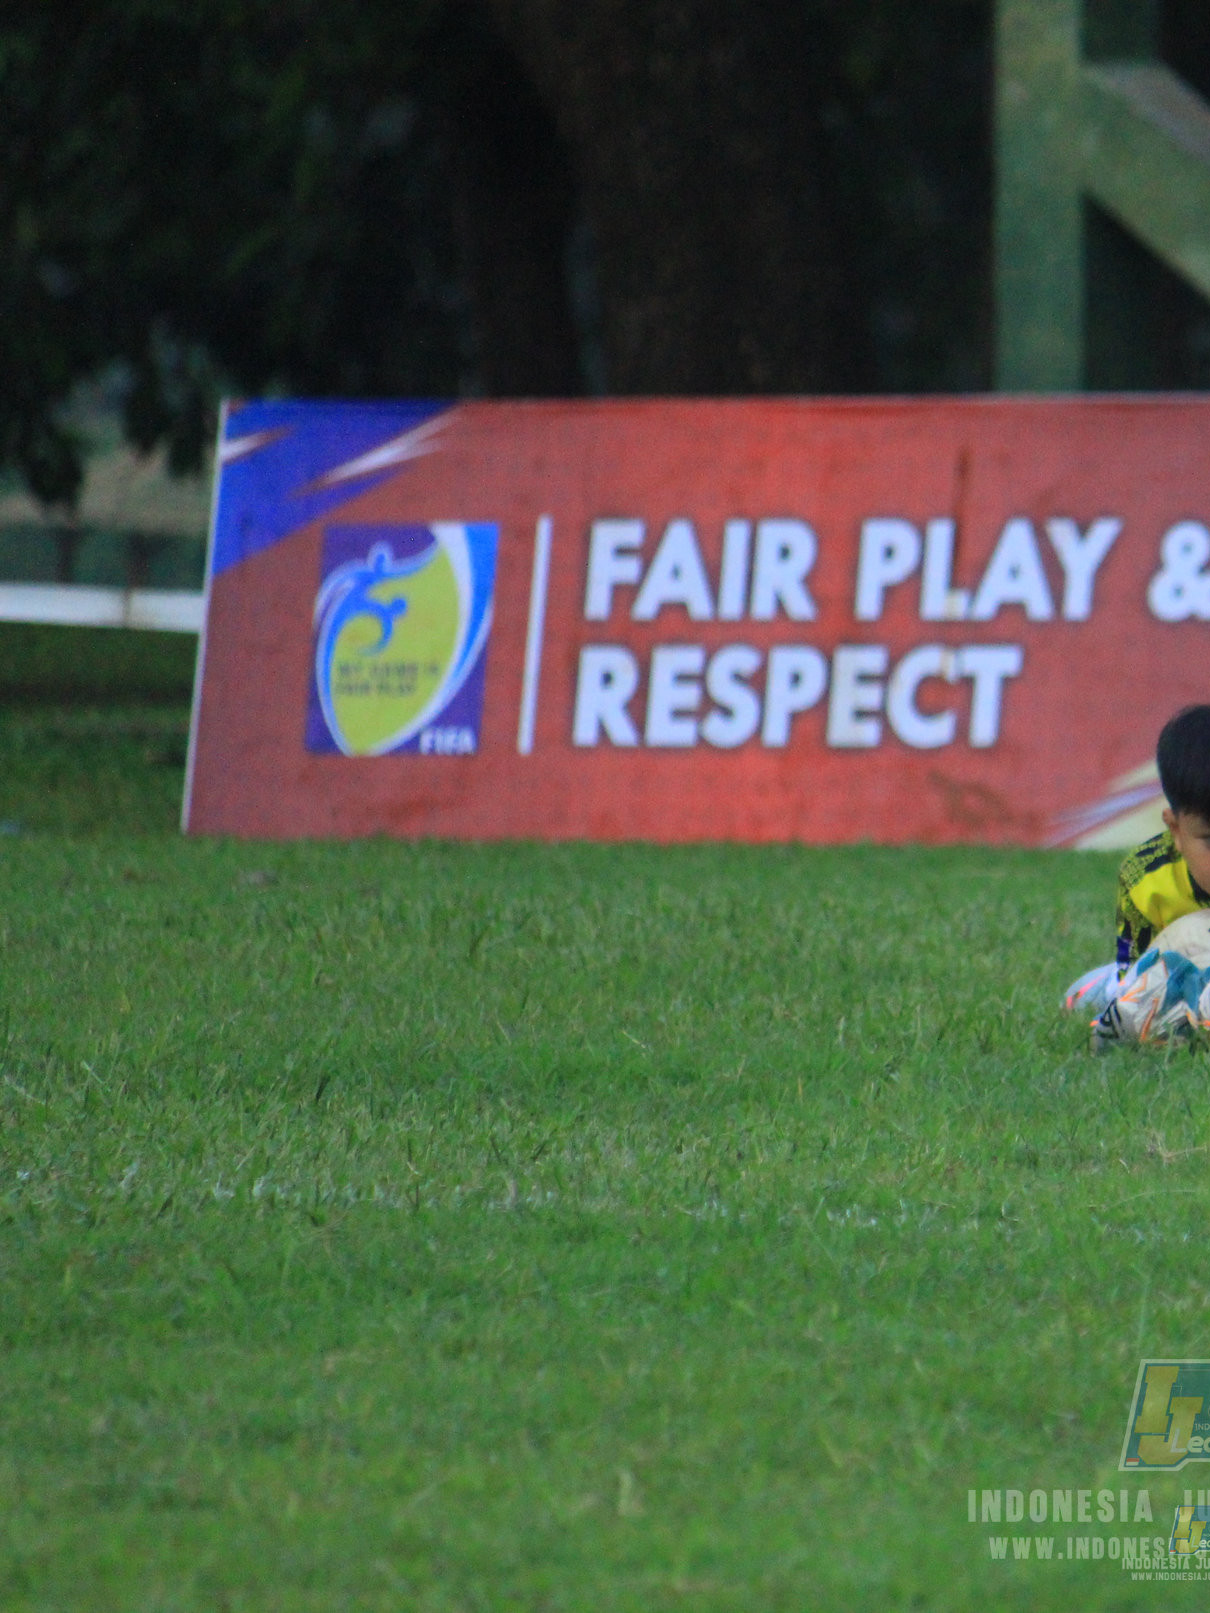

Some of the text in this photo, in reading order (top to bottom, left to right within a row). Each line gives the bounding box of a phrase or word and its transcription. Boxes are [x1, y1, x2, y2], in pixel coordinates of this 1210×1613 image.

[585, 518, 818, 621] FAIR
[855, 518, 1123, 621] PLAY
[573, 644, 1025, 749] RESPECT
